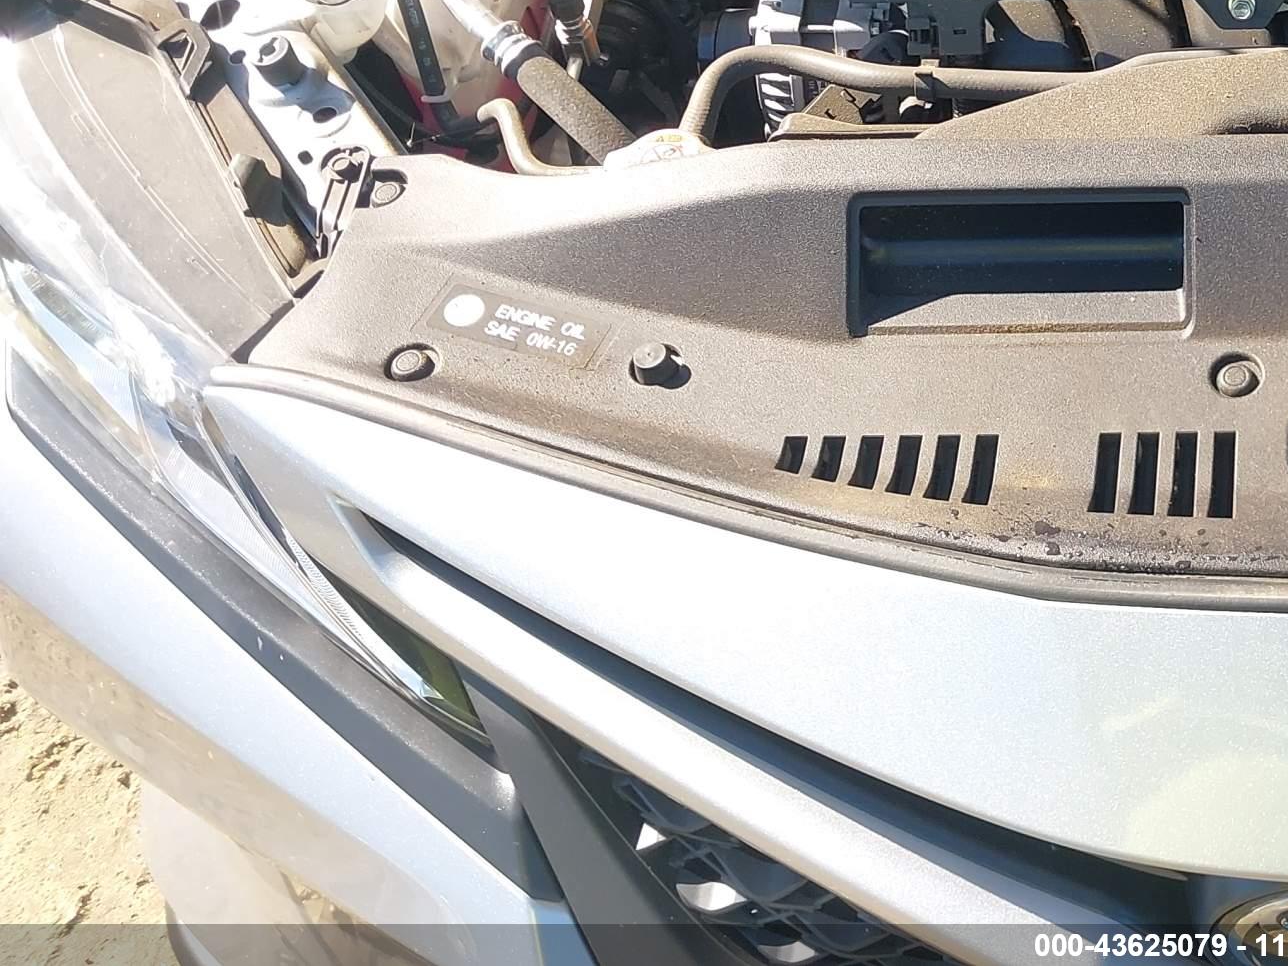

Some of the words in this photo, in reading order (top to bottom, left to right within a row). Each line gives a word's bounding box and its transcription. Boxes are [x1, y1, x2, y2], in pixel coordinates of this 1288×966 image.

[484, 321, 521, 342] SAE
[526, 332, 578, 356] 0W-16
[495, 304, 557, 331] ENGINE
[560, 322, 585, 340] OIL
